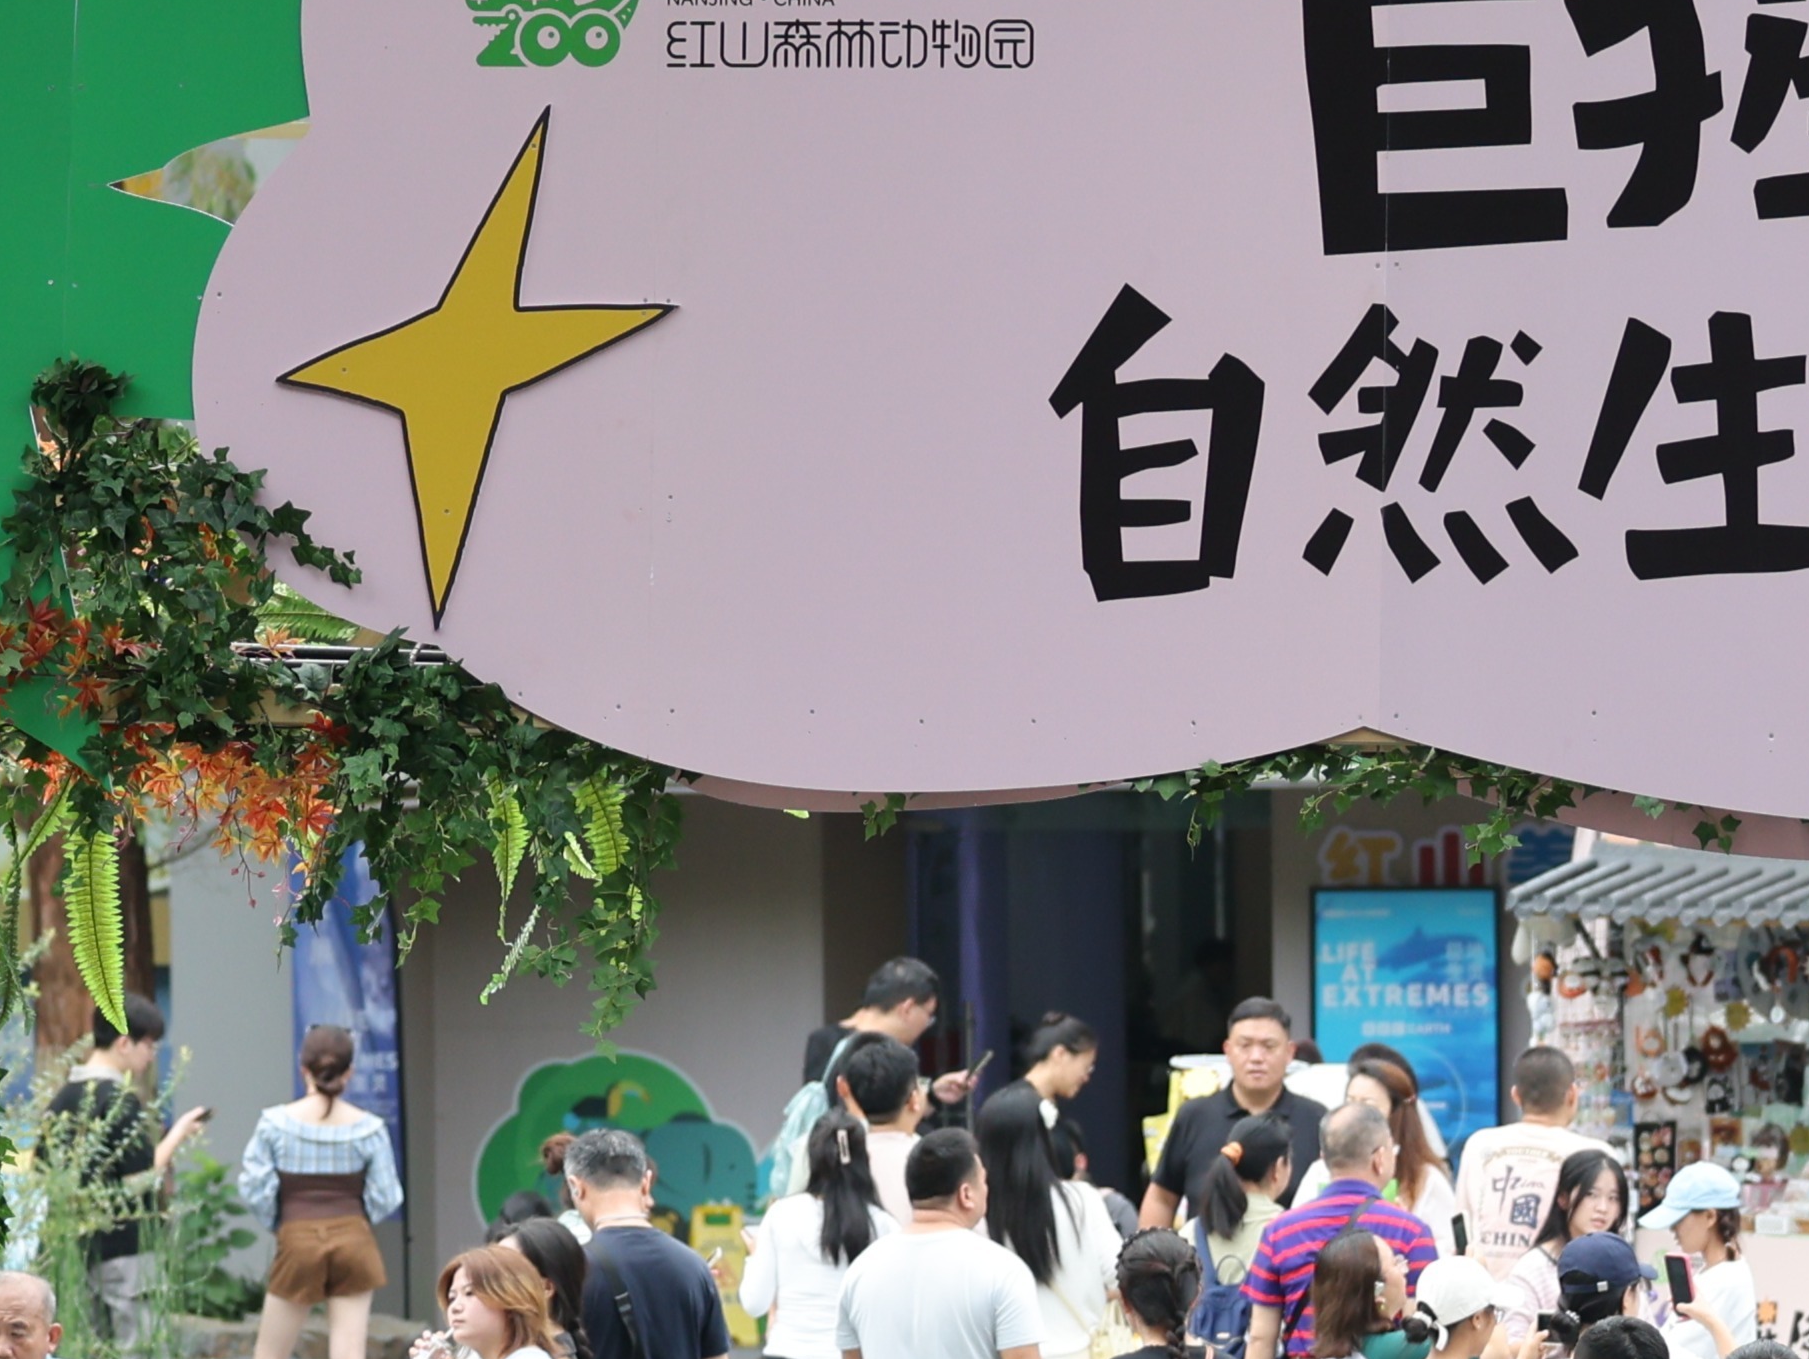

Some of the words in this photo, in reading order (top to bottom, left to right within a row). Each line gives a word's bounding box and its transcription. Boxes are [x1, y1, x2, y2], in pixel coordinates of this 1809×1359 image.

[666, 18, 1035, 69] 红山森林动物园
[1320, 941, 1376, 964] LIFE
[1342, 962, 1376, 983] AT
[1322, 981, 1490, 1008] EXTREMES
[1481, 1229, 1533, 1248] CHIN
